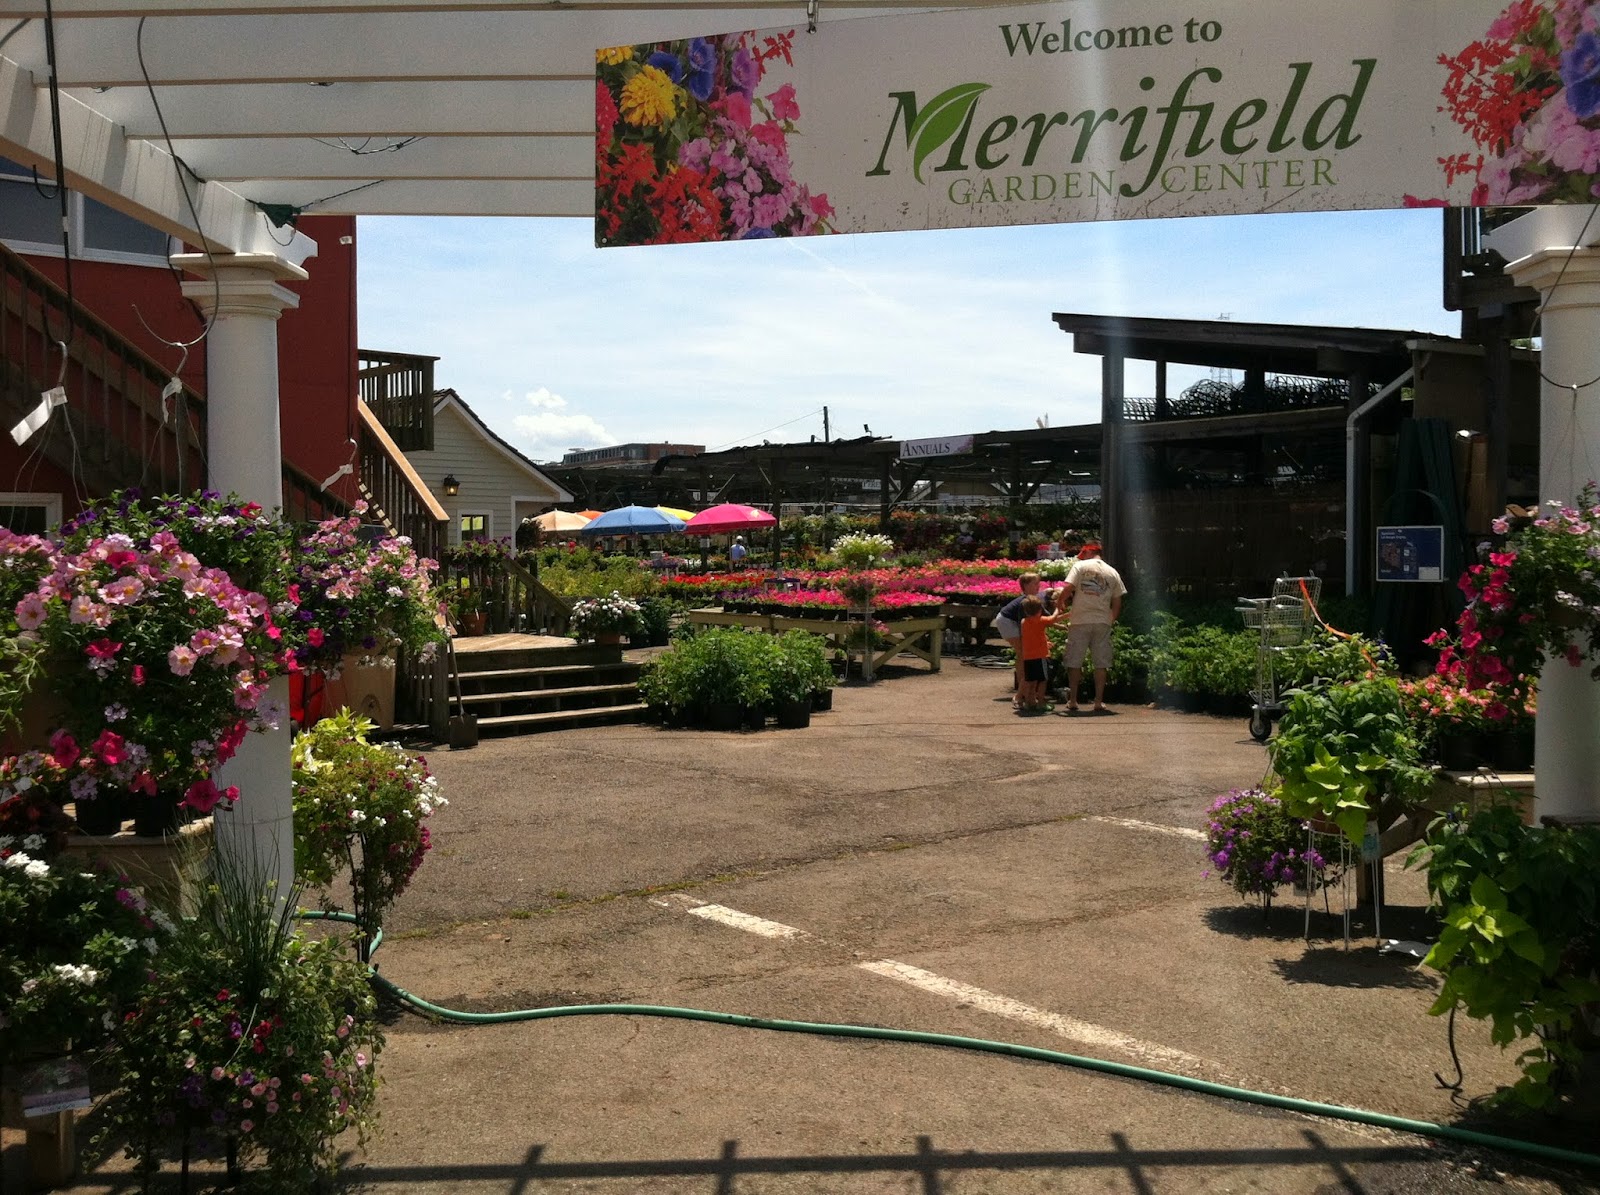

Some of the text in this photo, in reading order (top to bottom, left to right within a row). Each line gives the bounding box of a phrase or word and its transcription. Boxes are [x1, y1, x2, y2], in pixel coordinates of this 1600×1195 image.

[998, 17, 1223, 57] Welcome to
[865, 59, 1378, 198] Merrifield
[948, 158, 1338, 205] GARDEN CENTER
[902, 442, 951, 457] ANNUALS
